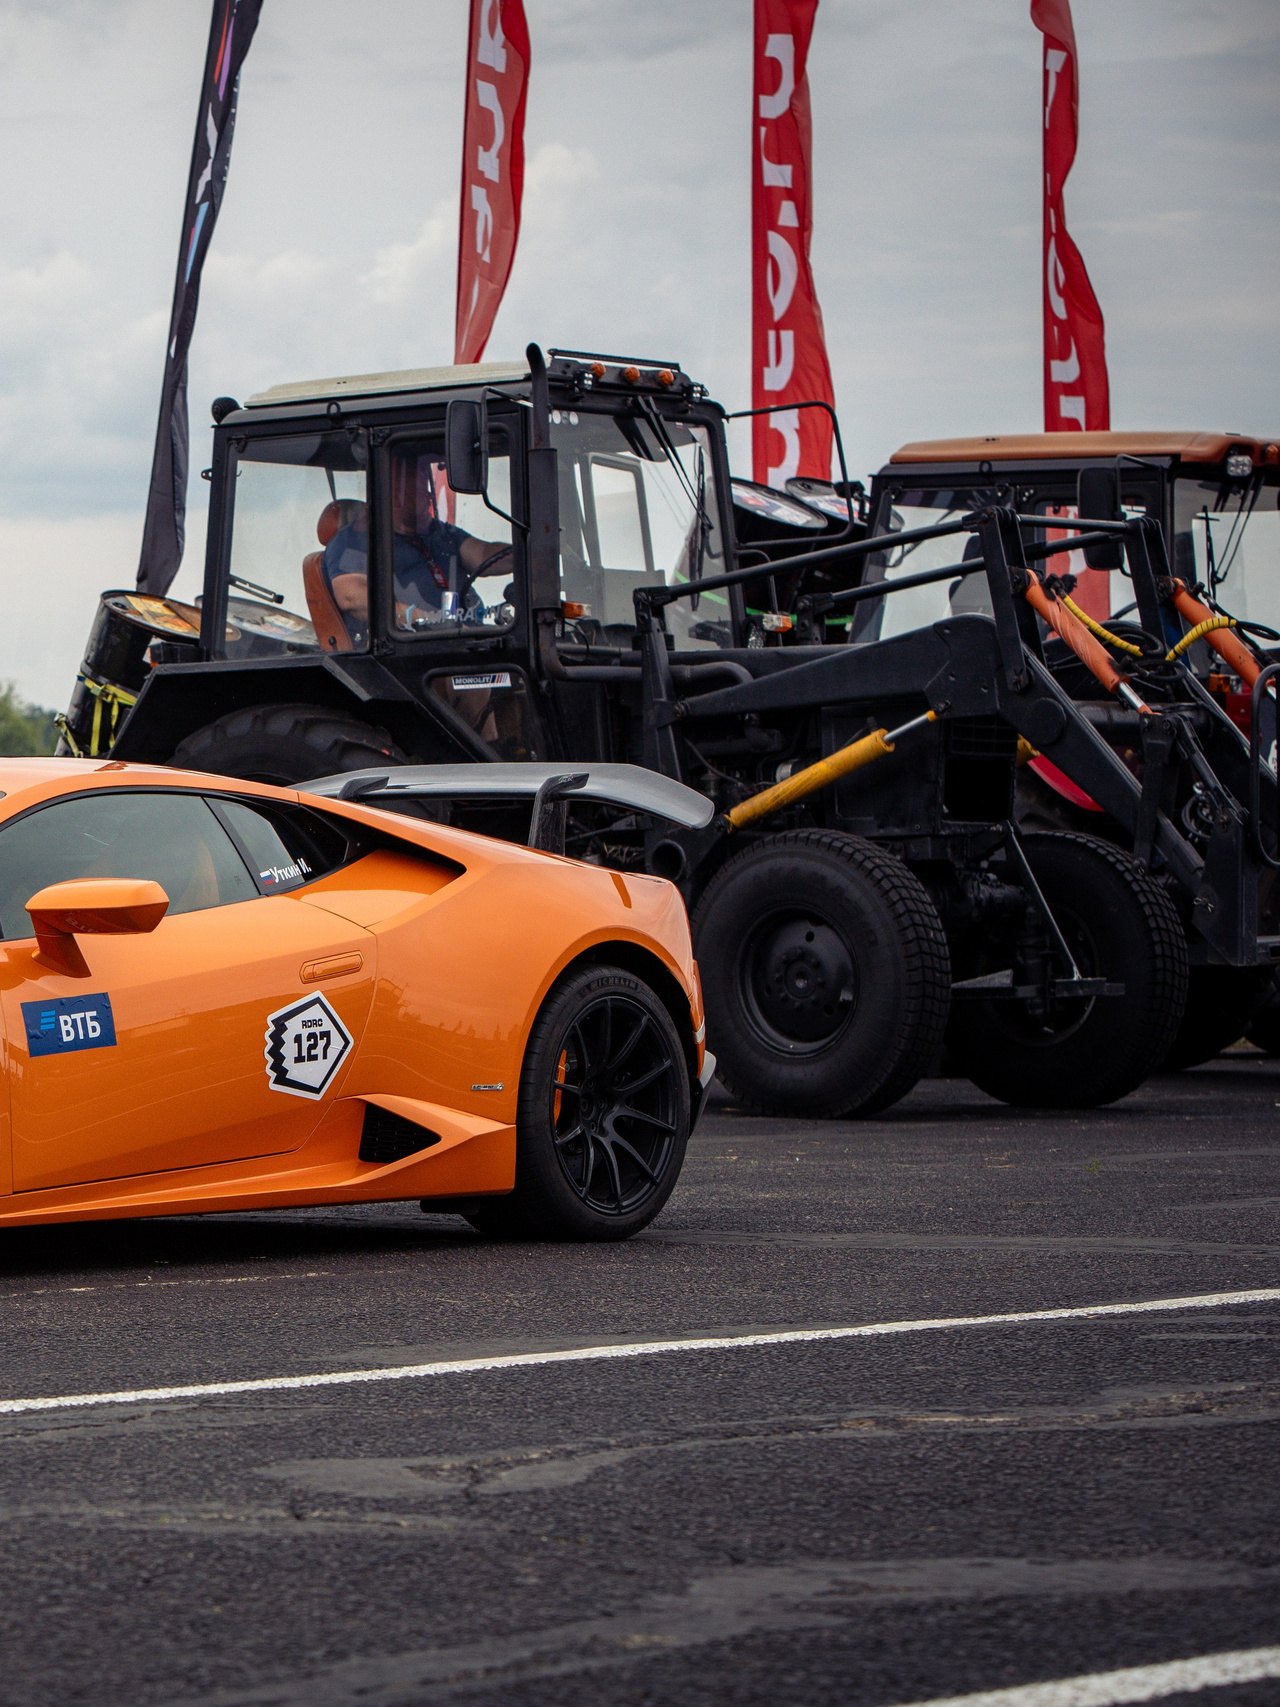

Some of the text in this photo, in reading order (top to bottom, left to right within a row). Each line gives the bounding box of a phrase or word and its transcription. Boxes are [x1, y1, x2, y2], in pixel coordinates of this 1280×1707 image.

[760, 34, 800, 490] uto.ru
[455, 676, 490, 684] MONOLIT
[269, 864, 302, 883] Уткин
[589, 976, 638, 991] MICHELIN
[59, 1010, 101, 1042] ВТБ
[301, 1018, 323, 1029] RDRC
[293, 1030, 331, 1064] 127
